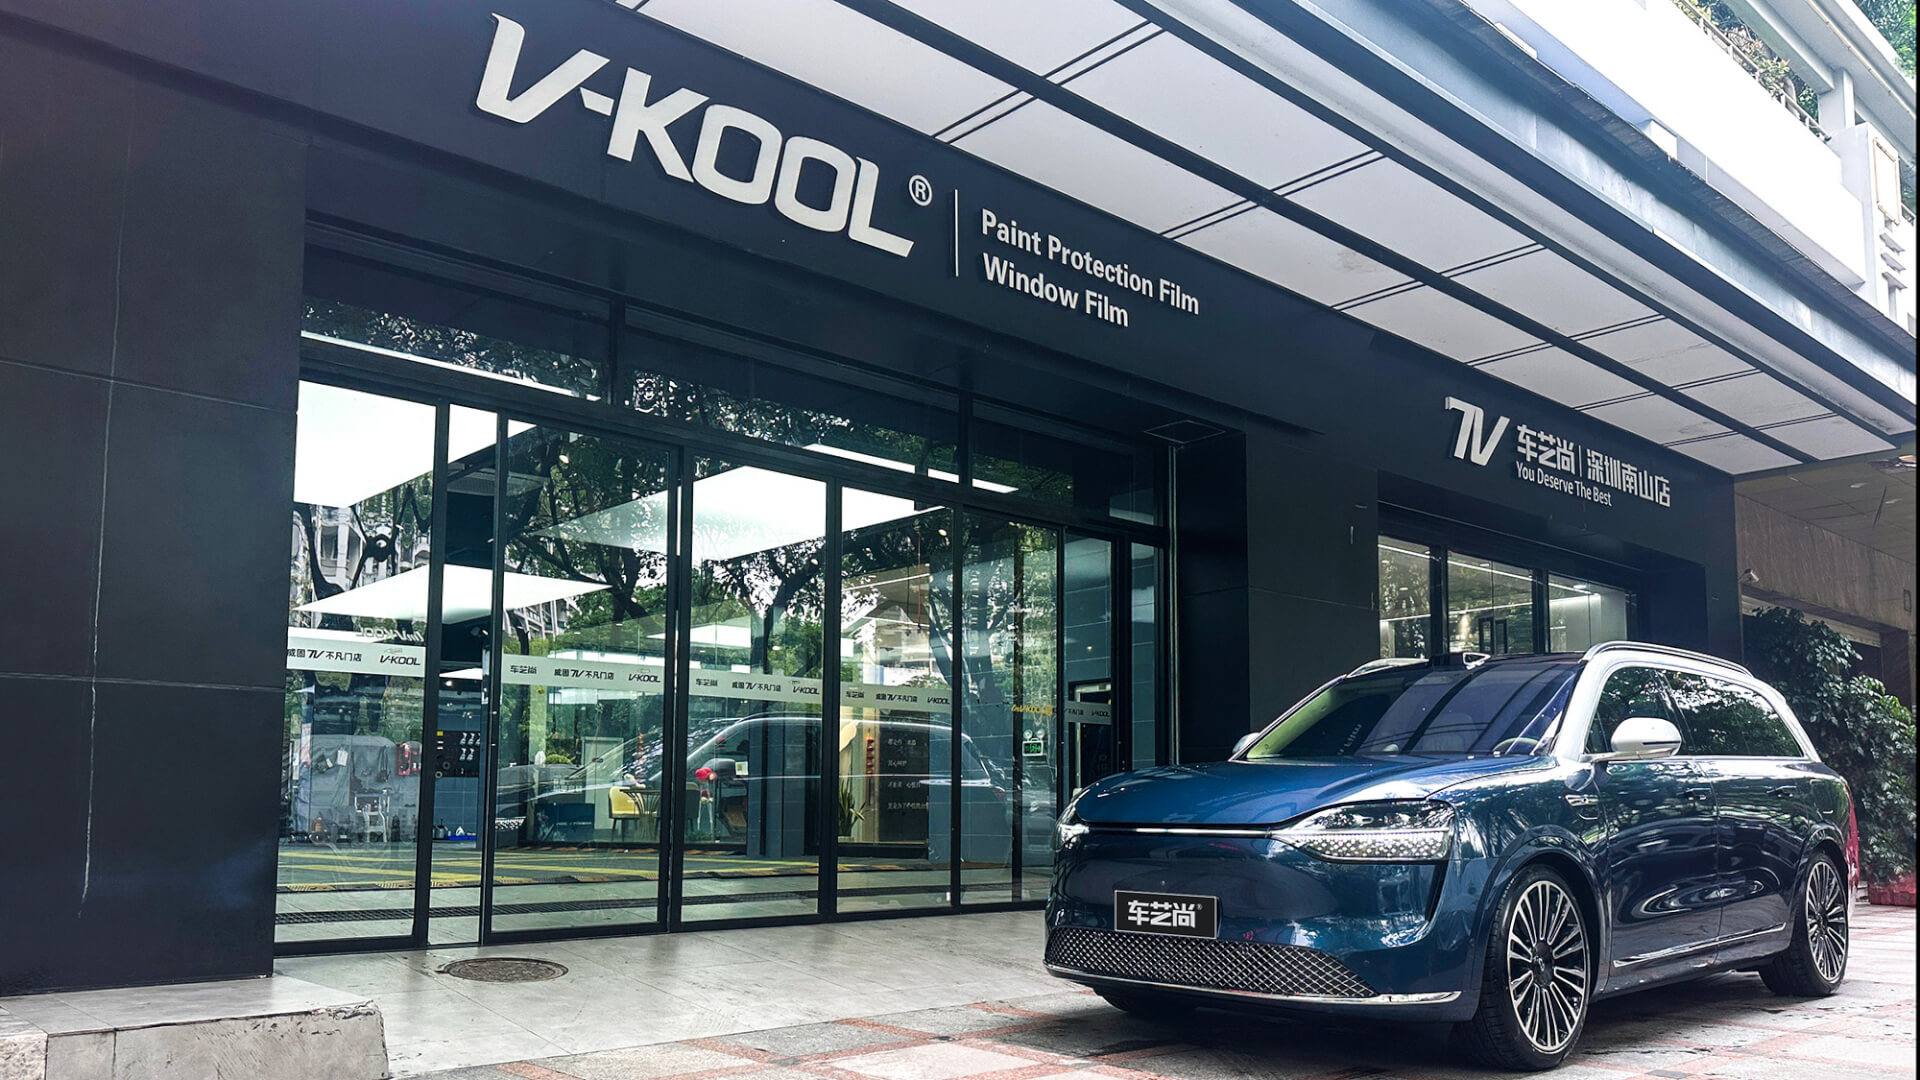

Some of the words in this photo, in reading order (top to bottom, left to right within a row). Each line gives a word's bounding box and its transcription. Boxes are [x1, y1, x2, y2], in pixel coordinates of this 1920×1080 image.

[475, 12, 915, 258] V-KOOL
[981, 208, 1042, 256] Paint
[1047, 234, 1154, 298] Protection
[1159, 277, 1200, 315] Film
[982, 252, 1079, 310] Window
[1085, 288, 1129, 327] Film
[1516, 423, 1575, 475] 车艺尚
[1586, 448, 1671, 508] 深圳南山店
[1516, 460, 1535, 482] You
[1536, 467, 1573, 495] Deserve
[1574, 480, 1592, 500] The
[1592, 486, 1612, 507] Best
[379, 655, 421, 666] V-KOOL
[628, 673, 661, 683] V-KOOL
[792, 685, 820, 695] V-KOOL
[1127, 899, 1196, 928] 车艺尚
